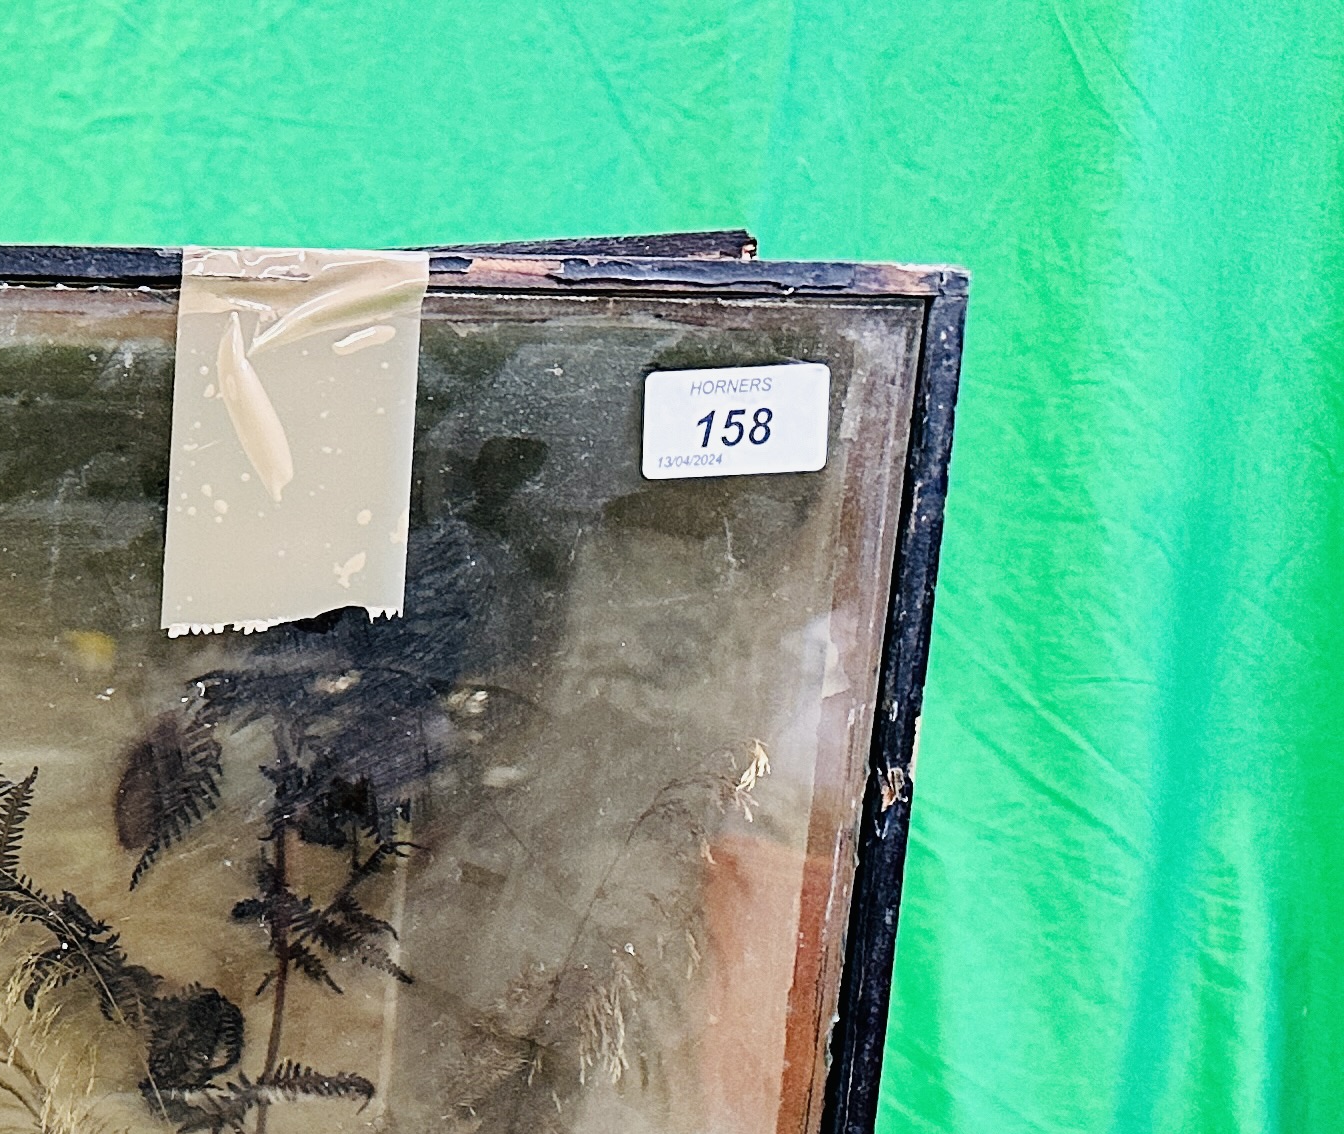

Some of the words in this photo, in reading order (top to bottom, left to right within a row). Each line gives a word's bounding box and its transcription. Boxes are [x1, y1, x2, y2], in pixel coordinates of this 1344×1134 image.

[690, 377, 773, 396] HORNERS
[696, 407, 773, 448] 158
[658, 453, 723, 468] 13/04/2024
